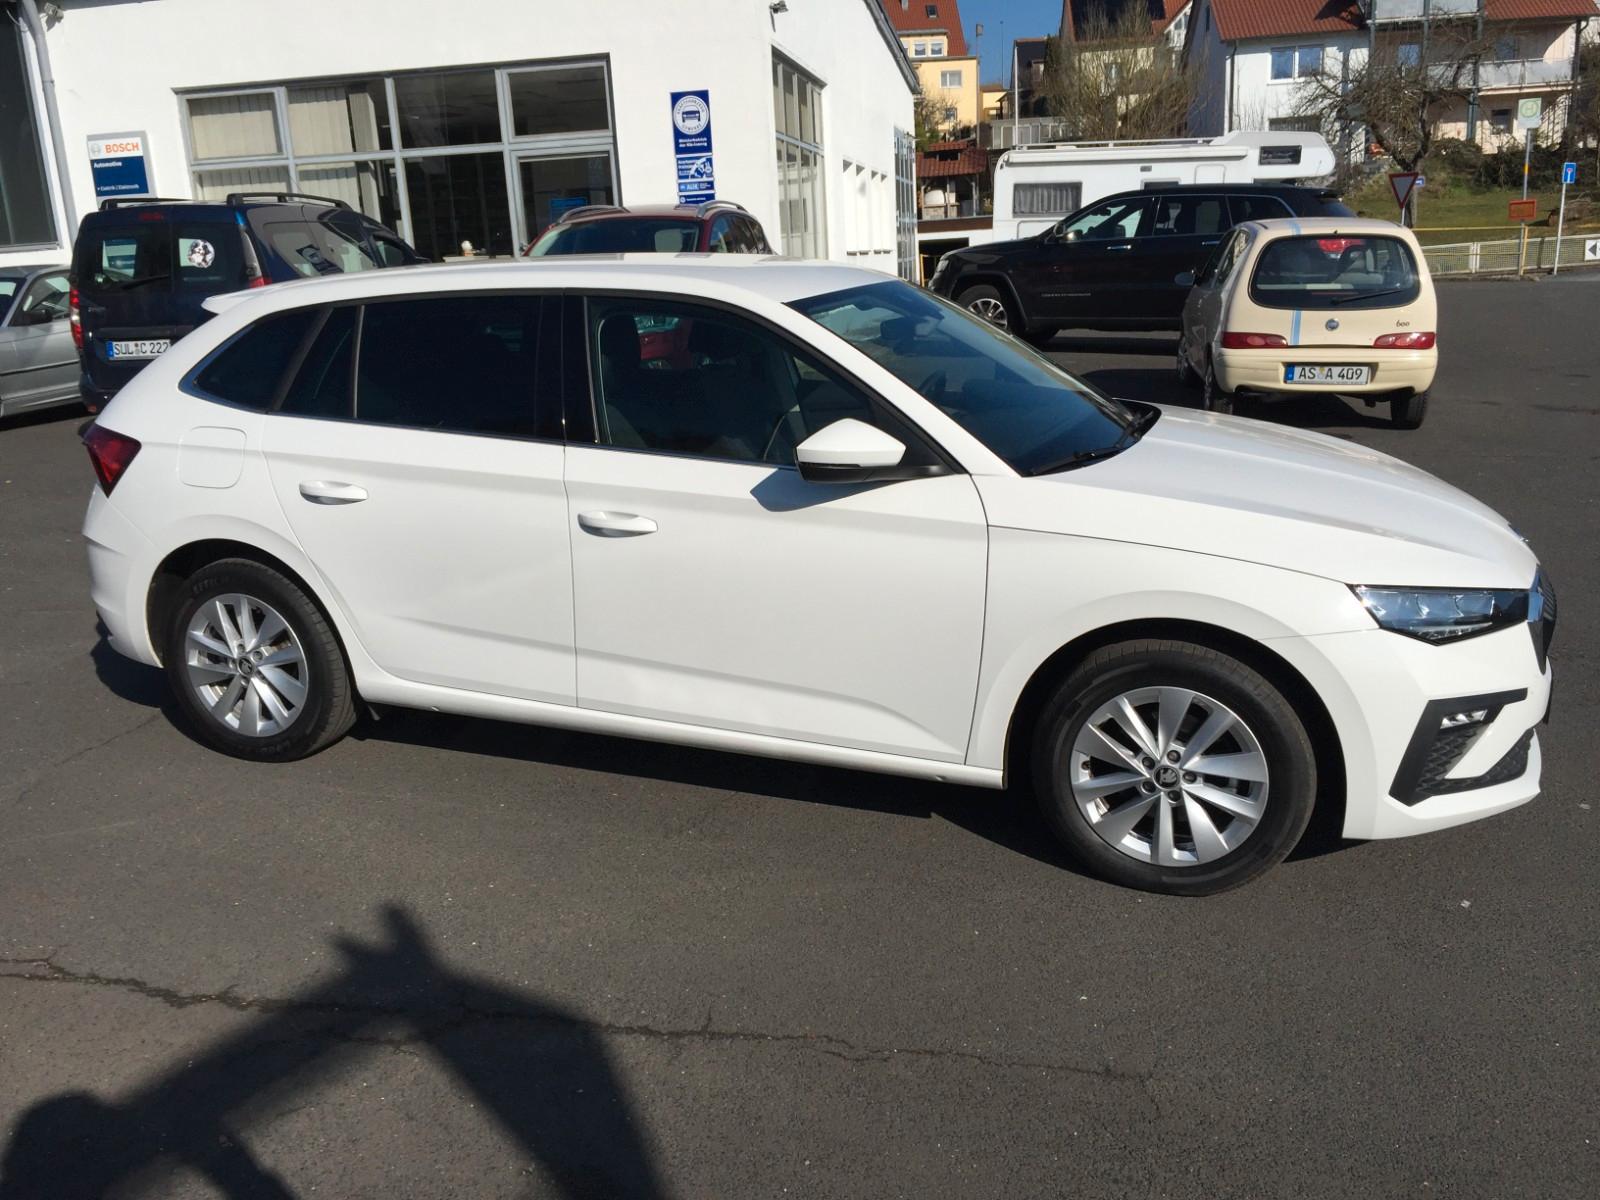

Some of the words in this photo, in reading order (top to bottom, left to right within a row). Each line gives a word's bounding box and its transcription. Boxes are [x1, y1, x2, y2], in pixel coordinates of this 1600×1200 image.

[105, 142, 140, 154] BOSCH
[114, 343, 134, 356] SUL
[140, 342, 147, 354] C
[149, 341, 169, 354] 222
[1299, 367, 1316, 380] AS
[1325, 367, 1334, 380] A
[1337, 367, 1363, 381] 409
